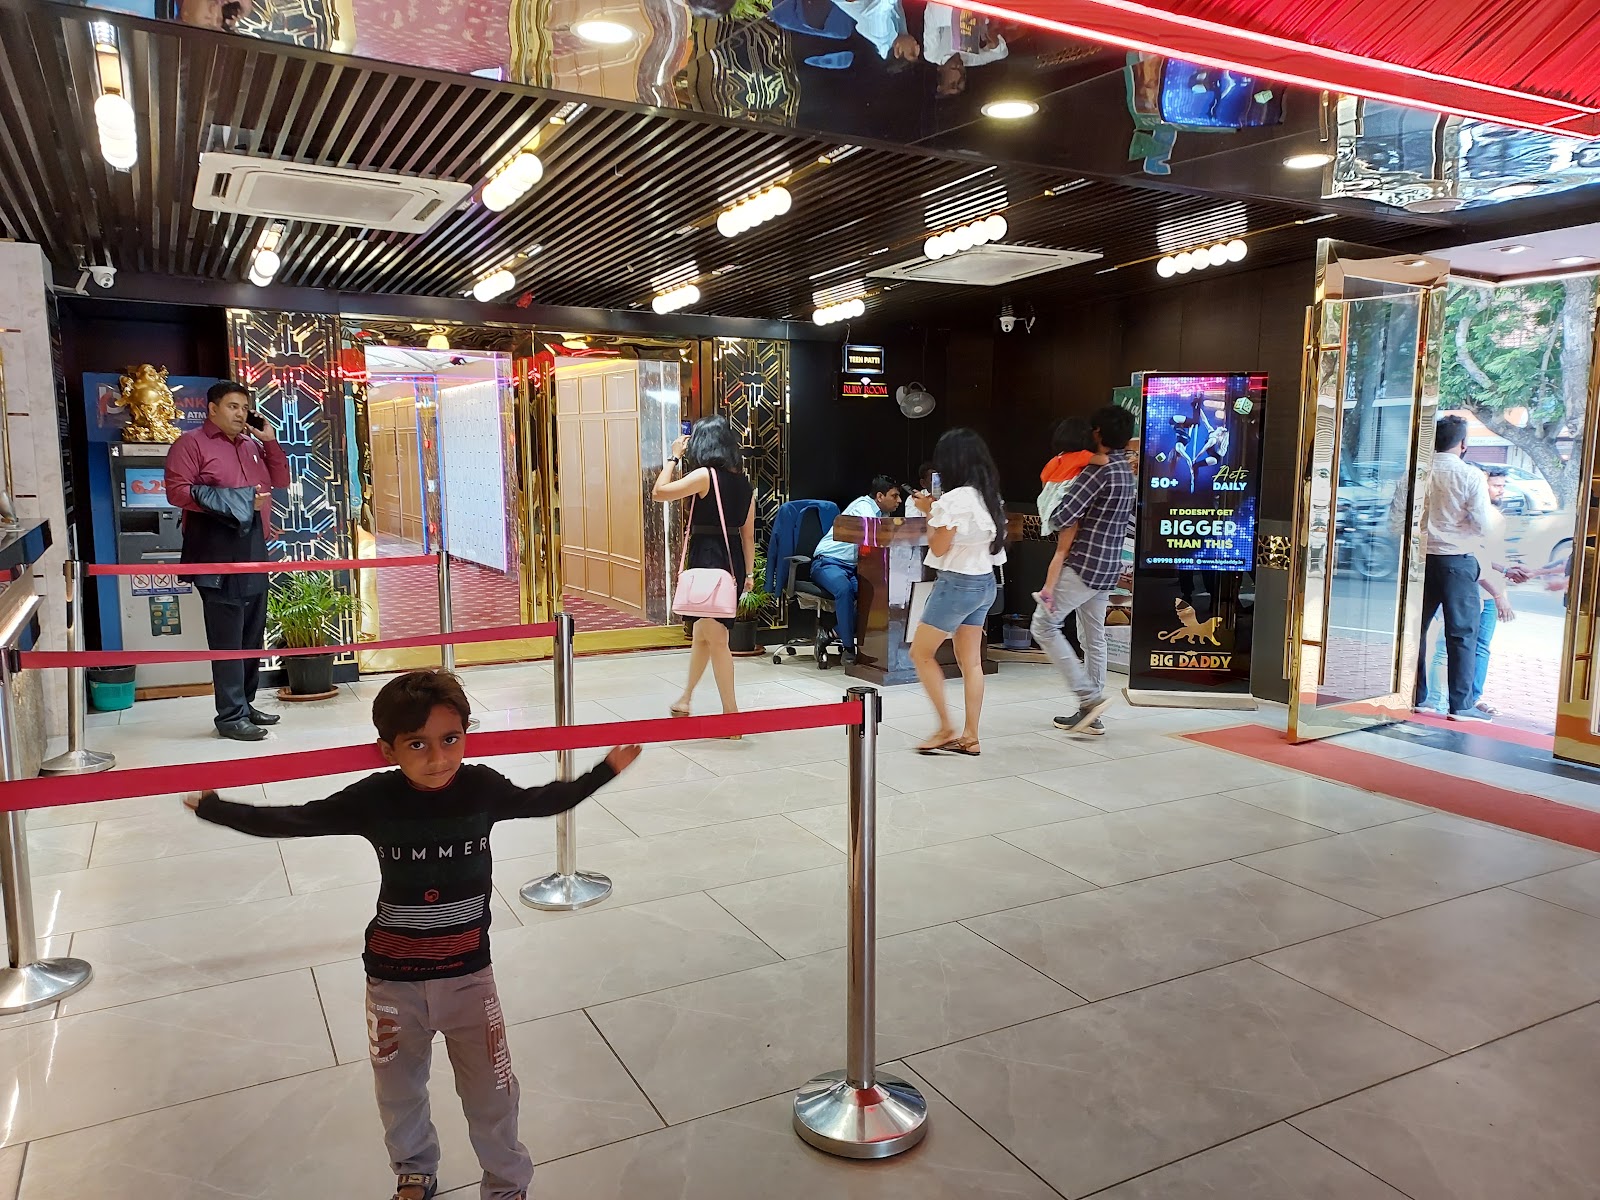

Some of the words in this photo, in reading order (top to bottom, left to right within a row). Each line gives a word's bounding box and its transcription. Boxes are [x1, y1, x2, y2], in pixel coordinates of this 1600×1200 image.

[849, 355, 863, 364] TEEN
[864, 356, 880, 364] PATTI
[843, 384, 863, 394] RUBY
[864, 385, 887, 394] ROOM
[187, 411, 207, 419] ATM
[1212, 465, 1249, 482] Acts
[1150, 477, 1179, 489] 50+
[1212, 481, 1248, 491] DAILY
[1169, 508, 1178, 516] IT
[1178, 508, 1216, 517] DOESN'T
[1216, 509, 1234, 517] GET
[1160, 519, 1238, 536] BIGGER
[1166, 538, 1202, 549] THAN
[1204, 538, 1234, 549] THIS
[1150, 654, 1173, 667] BIG
[1178, 654, 1232, 669] DADDY
[378, 837, 488, 861] SUMMER
